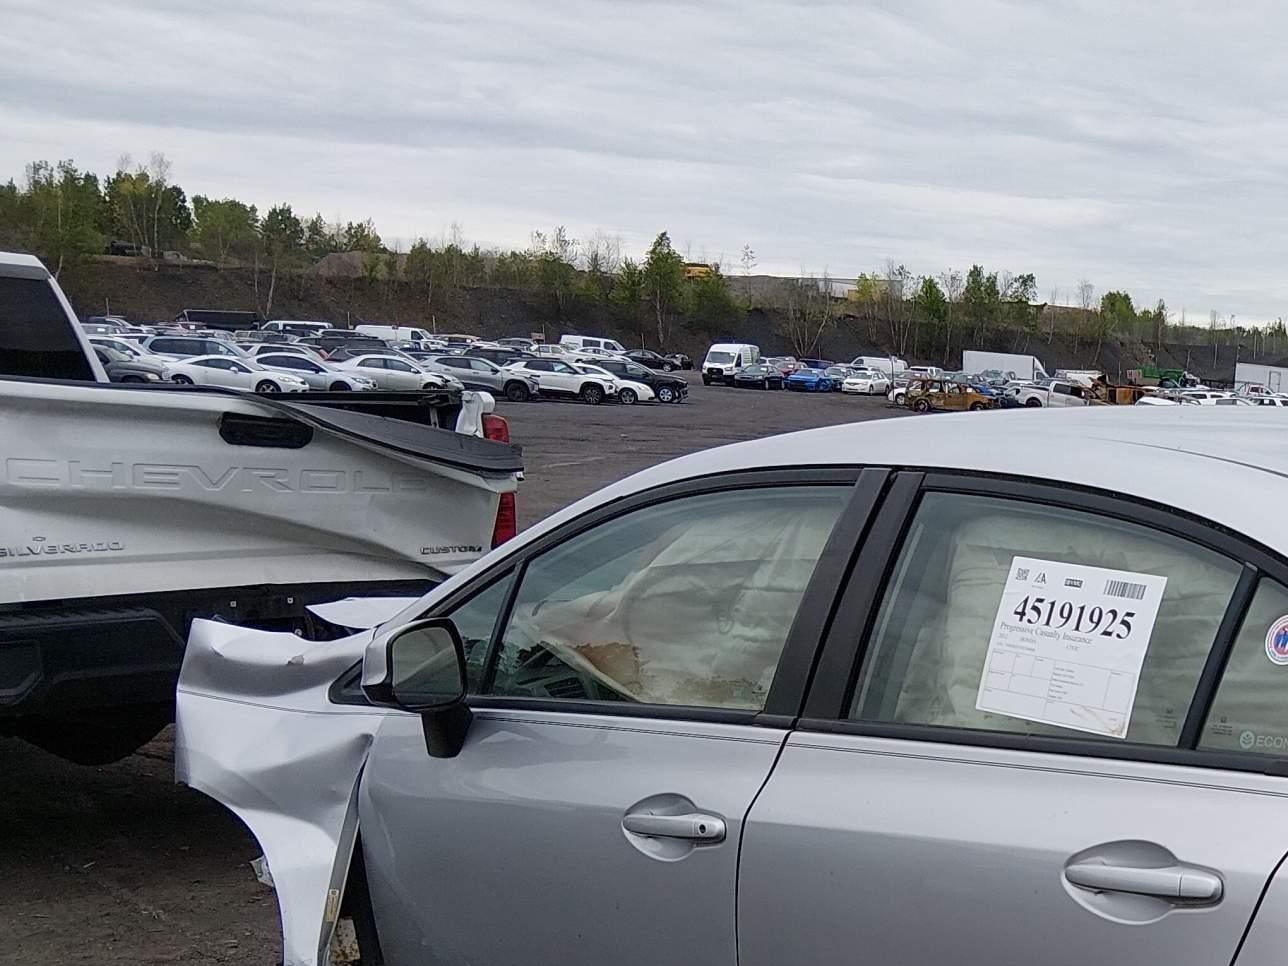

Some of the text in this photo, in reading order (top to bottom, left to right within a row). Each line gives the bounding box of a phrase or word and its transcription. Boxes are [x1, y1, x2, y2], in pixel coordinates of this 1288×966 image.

[6, 457, 428, 494] CHEVROLE
[420, 545, 482, 556] CUSTOM
[1013, 593, 1137, 641] 45191925
[999, 621, 1036, 637] Progressive
[1034, 626, 1061, 641] Casualty
[1062, 631, 1094, 645] Insurance
